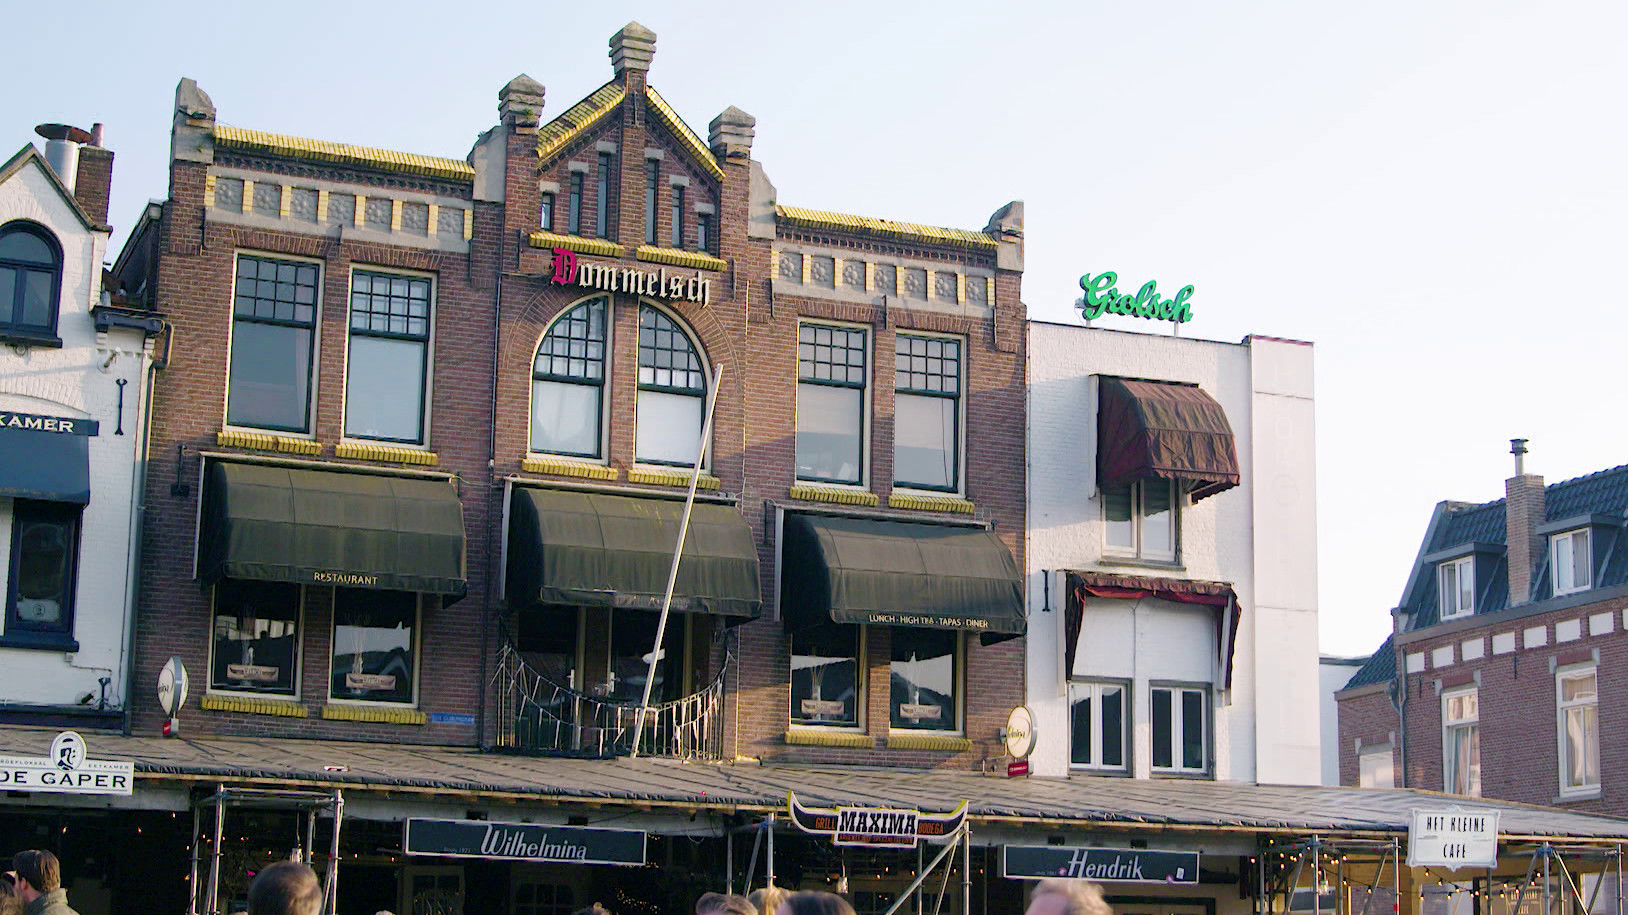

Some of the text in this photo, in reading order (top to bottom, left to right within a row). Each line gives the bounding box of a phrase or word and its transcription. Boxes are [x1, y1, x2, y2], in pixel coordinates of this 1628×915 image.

[551, 247, 712, 308] Dommelsch
[1079, 271, 1194, 323] Grolsch
[314, 572, 378, 585] RESTAURANT
[869, 614, 989, 628] LUNCH HIGH TEA TAPAS DINER
[41, 772, 127, 788] GAPER
[815, 817, 836, 830] GRILL
[839, 810, 916, 835] MAXIMA
[918, 821, 944, 835] BODEGA
[1427, 816, 1485, 832] HET KLEINE
[480, 823, 587, 860] Wilhelmina
[1443, 843, 1466, 858] CAFE
[1067, 849, 1145, 880] Hendrik
